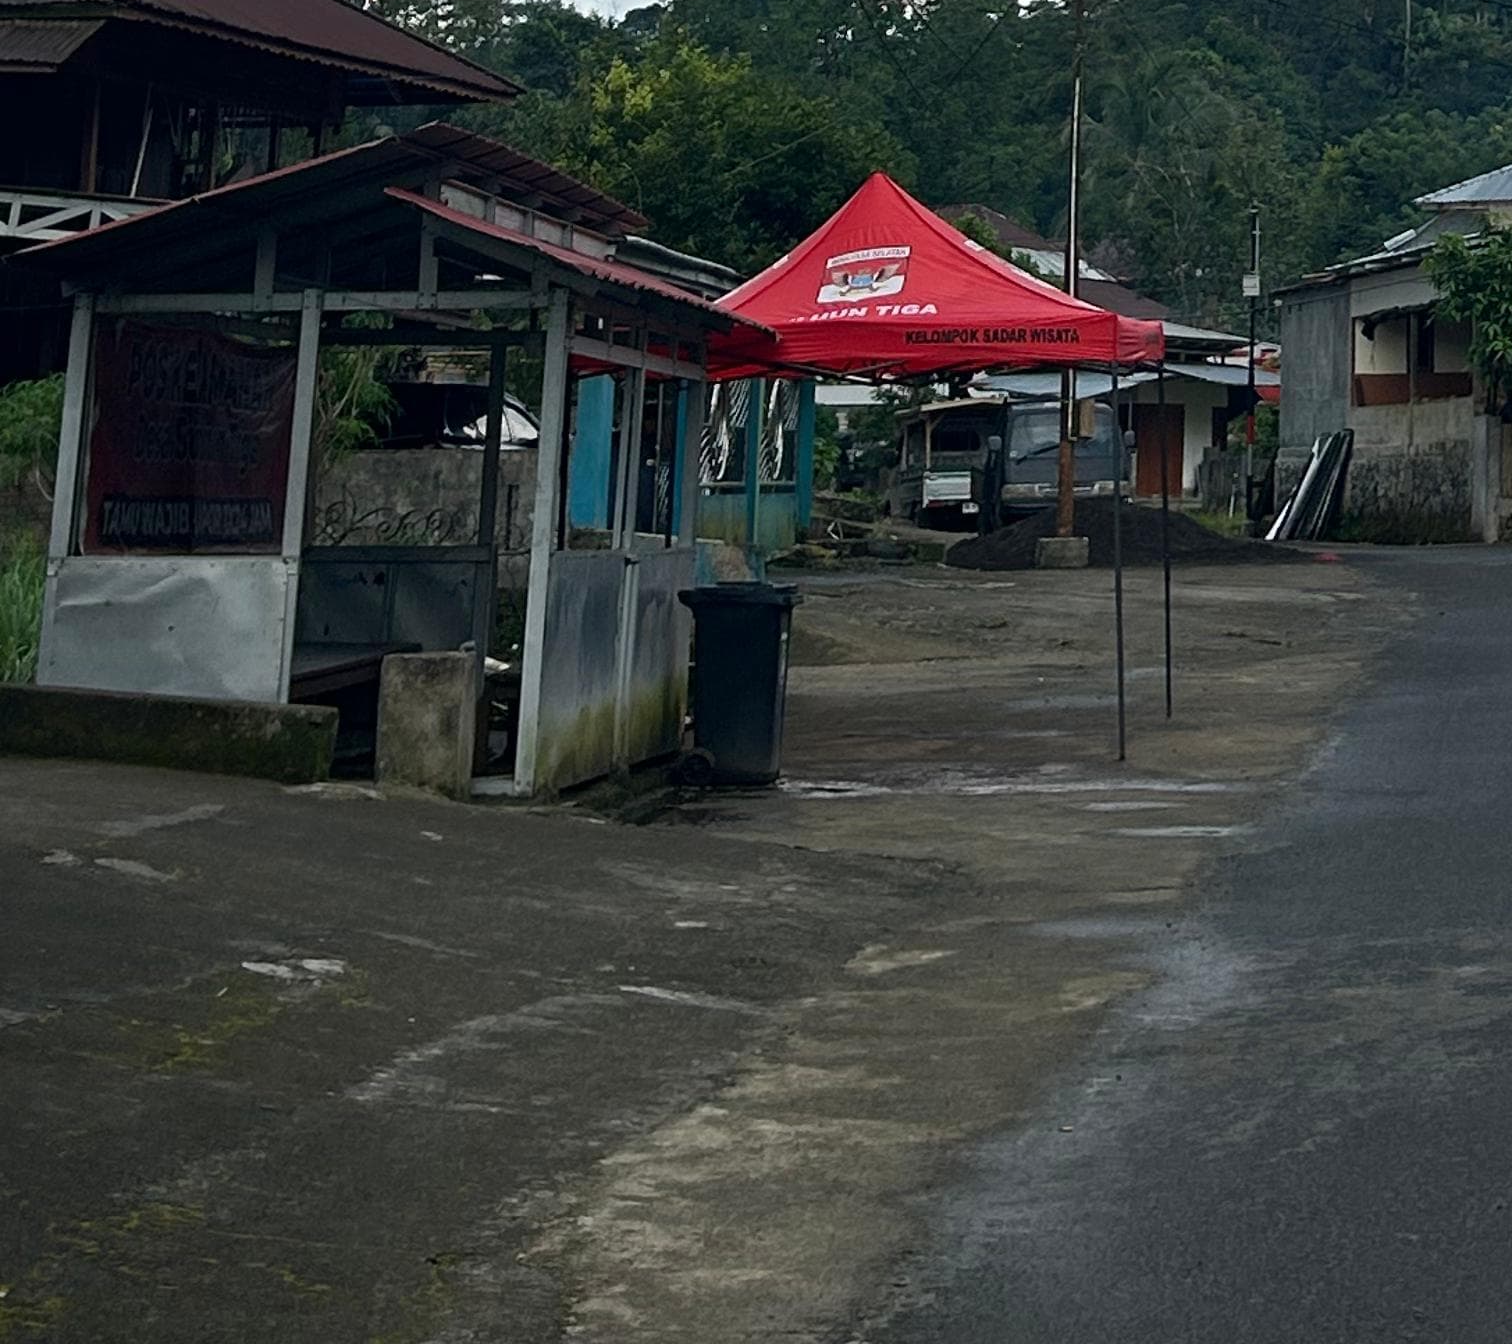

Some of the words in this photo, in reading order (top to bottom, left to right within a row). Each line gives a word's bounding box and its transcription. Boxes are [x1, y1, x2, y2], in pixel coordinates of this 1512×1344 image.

[876, 303, 938, 317] TIGA
[905, 328, 979, 344] KELOMPOK
[982, 327, 1027, 343] SADAR
[1030, 327, 1079, 343] WISATA
